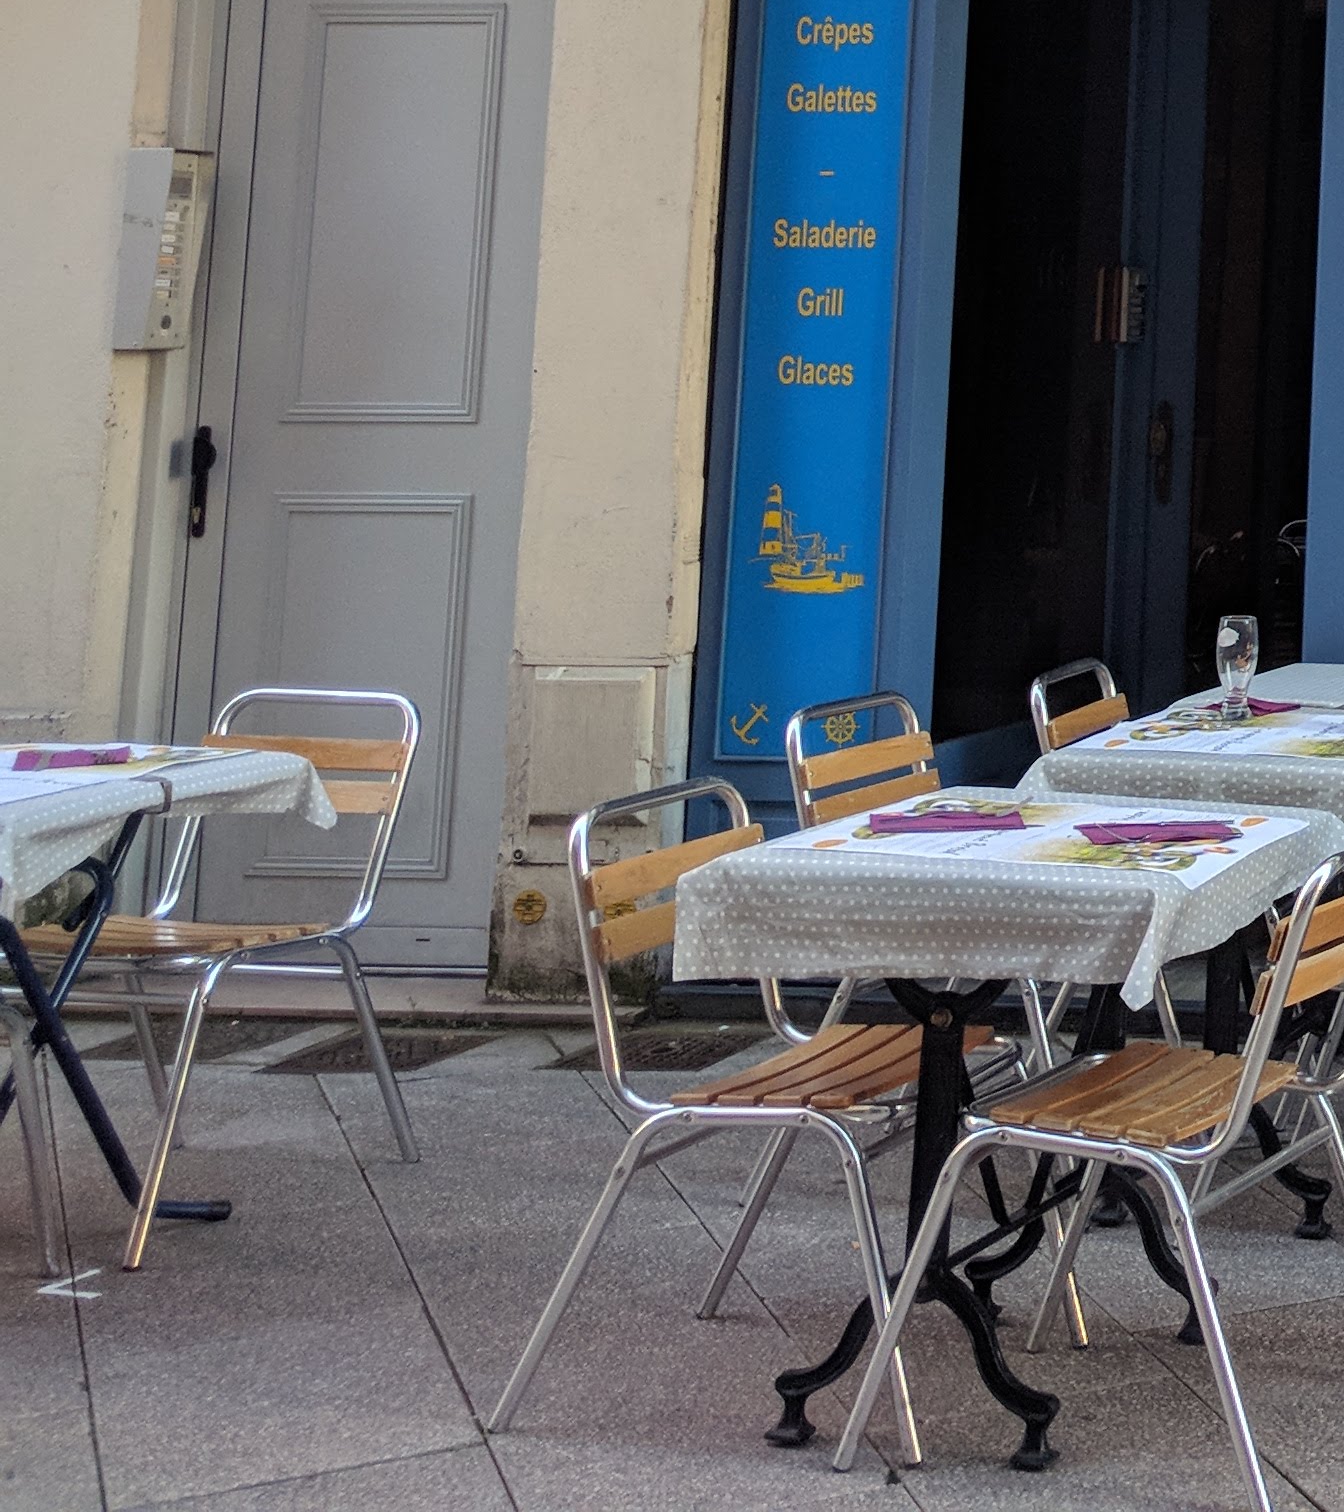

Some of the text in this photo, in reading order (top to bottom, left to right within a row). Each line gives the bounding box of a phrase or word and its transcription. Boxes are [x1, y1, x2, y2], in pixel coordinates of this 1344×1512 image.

[796, 15, 875, 52] Crêpes
[787, 83, 877, 113] Galettes
[773, 218, 876, 251] Saladerie
[797, 286, 844, 317] Grill
[777, 354, 854, 387] Glaces
